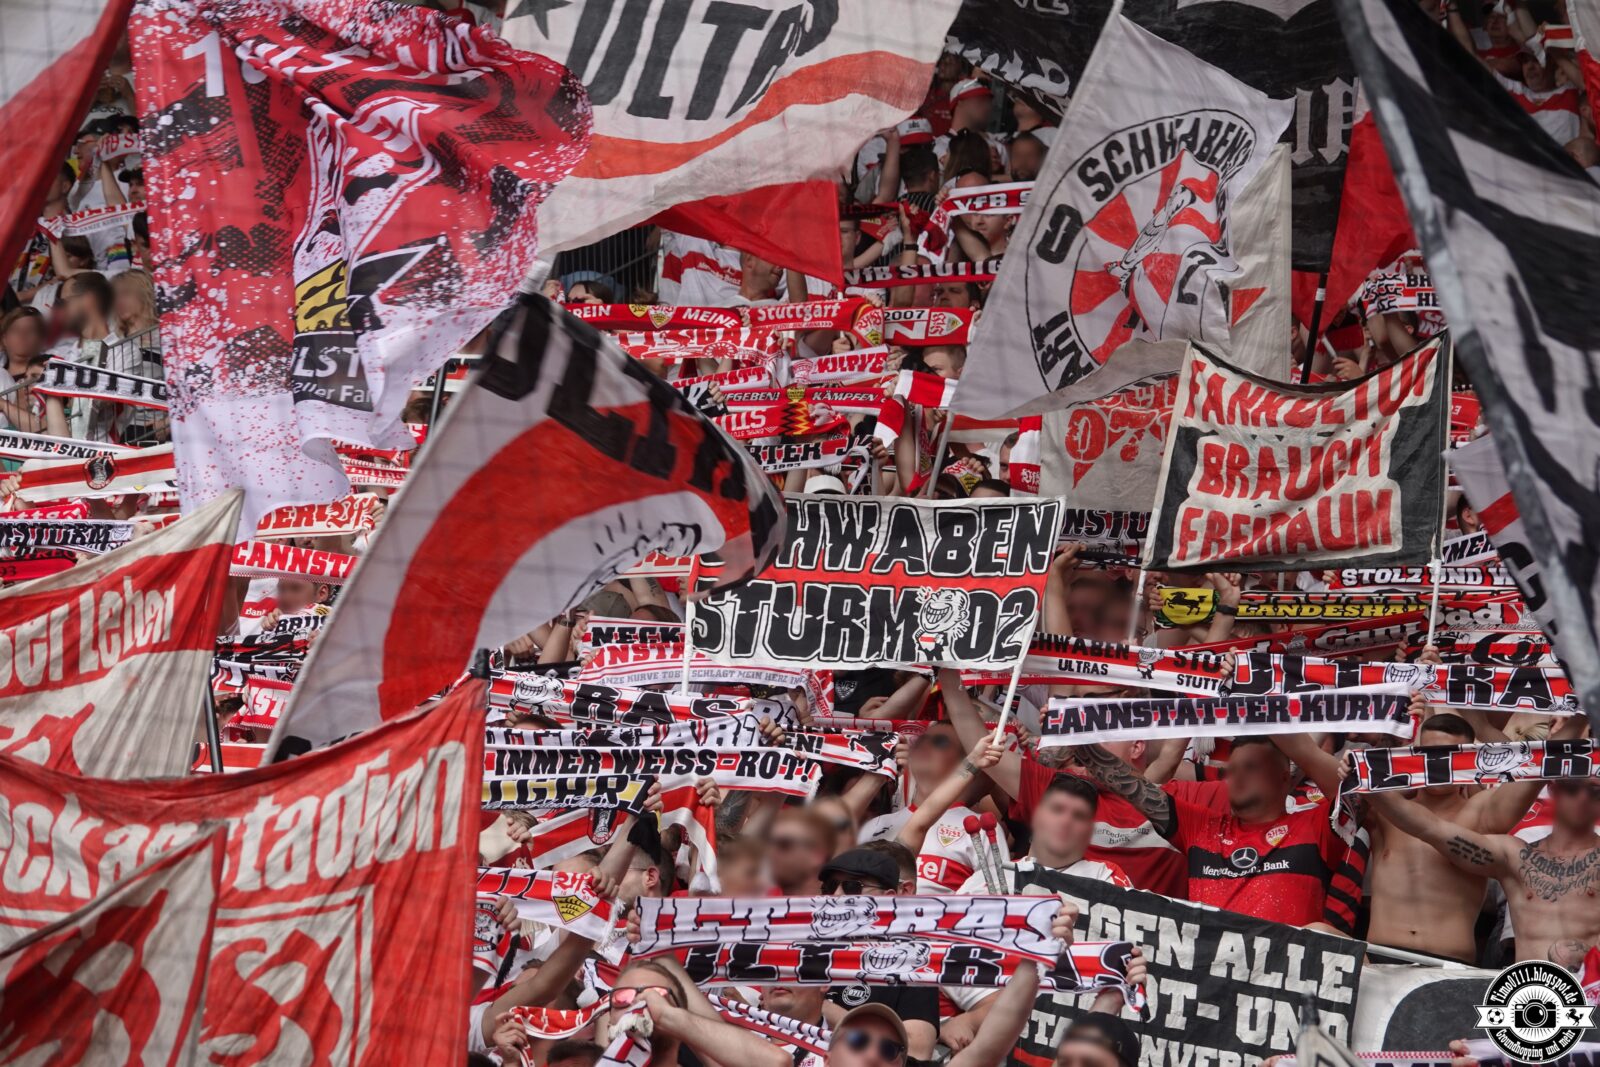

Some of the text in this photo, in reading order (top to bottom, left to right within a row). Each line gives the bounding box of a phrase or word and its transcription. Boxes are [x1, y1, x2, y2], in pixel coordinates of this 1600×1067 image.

[953, 192, 1008, 213] VfB
[844, 266, 894, 286] VfB
[682, 307, 739, 329] MEINE
[757, 301, 841, 322] Stuttgart
[884, 308, 926, 322] 2007
[816, 352, 884, 374] KURVE
[770, 499, 1060, 577] HWABEN
[1341, 567, 1423, 587] STOLZ
[690, 574, 1040, 664] STURM 02
[691, 669, 736, 679] SCHLAGT
[1057, 657, 1109, 676] ULTRAS
[1042, 694, 1290, 736] CANNSTATTER
[494, 749, 602, 776] IMMER
[1262, 859, 1291, 873] Bank
[1209, 930, 1357, 1005] ALLE
